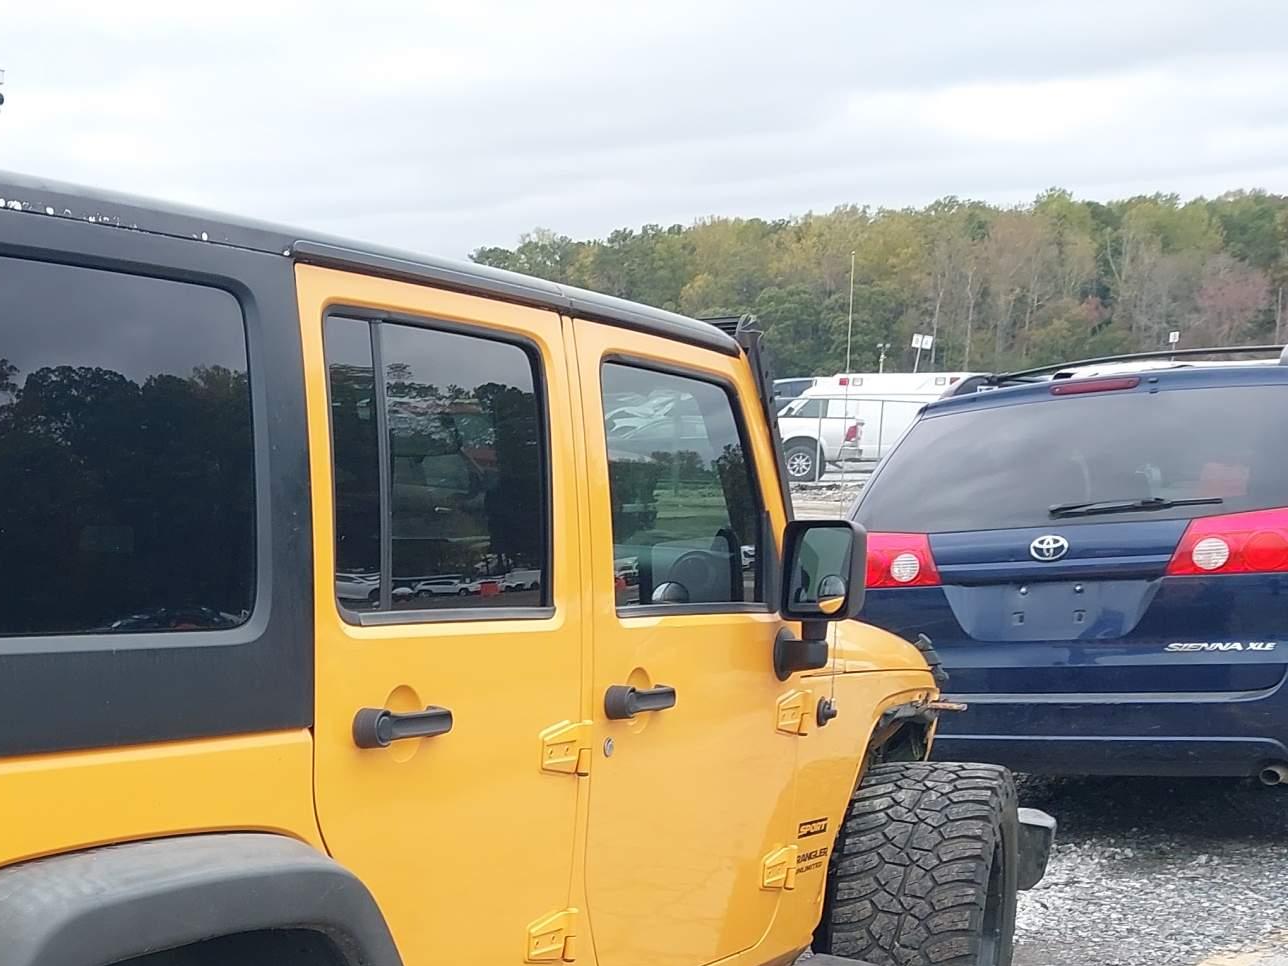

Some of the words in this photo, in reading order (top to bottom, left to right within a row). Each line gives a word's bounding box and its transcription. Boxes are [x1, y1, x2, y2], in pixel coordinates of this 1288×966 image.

[1164, 642, 1243, 652] SIENNA
[1246, 642, 1277, 651] XLE
[798, 820, 828, 837] SPORT
[796, 847, 828, 864] RANGLER
